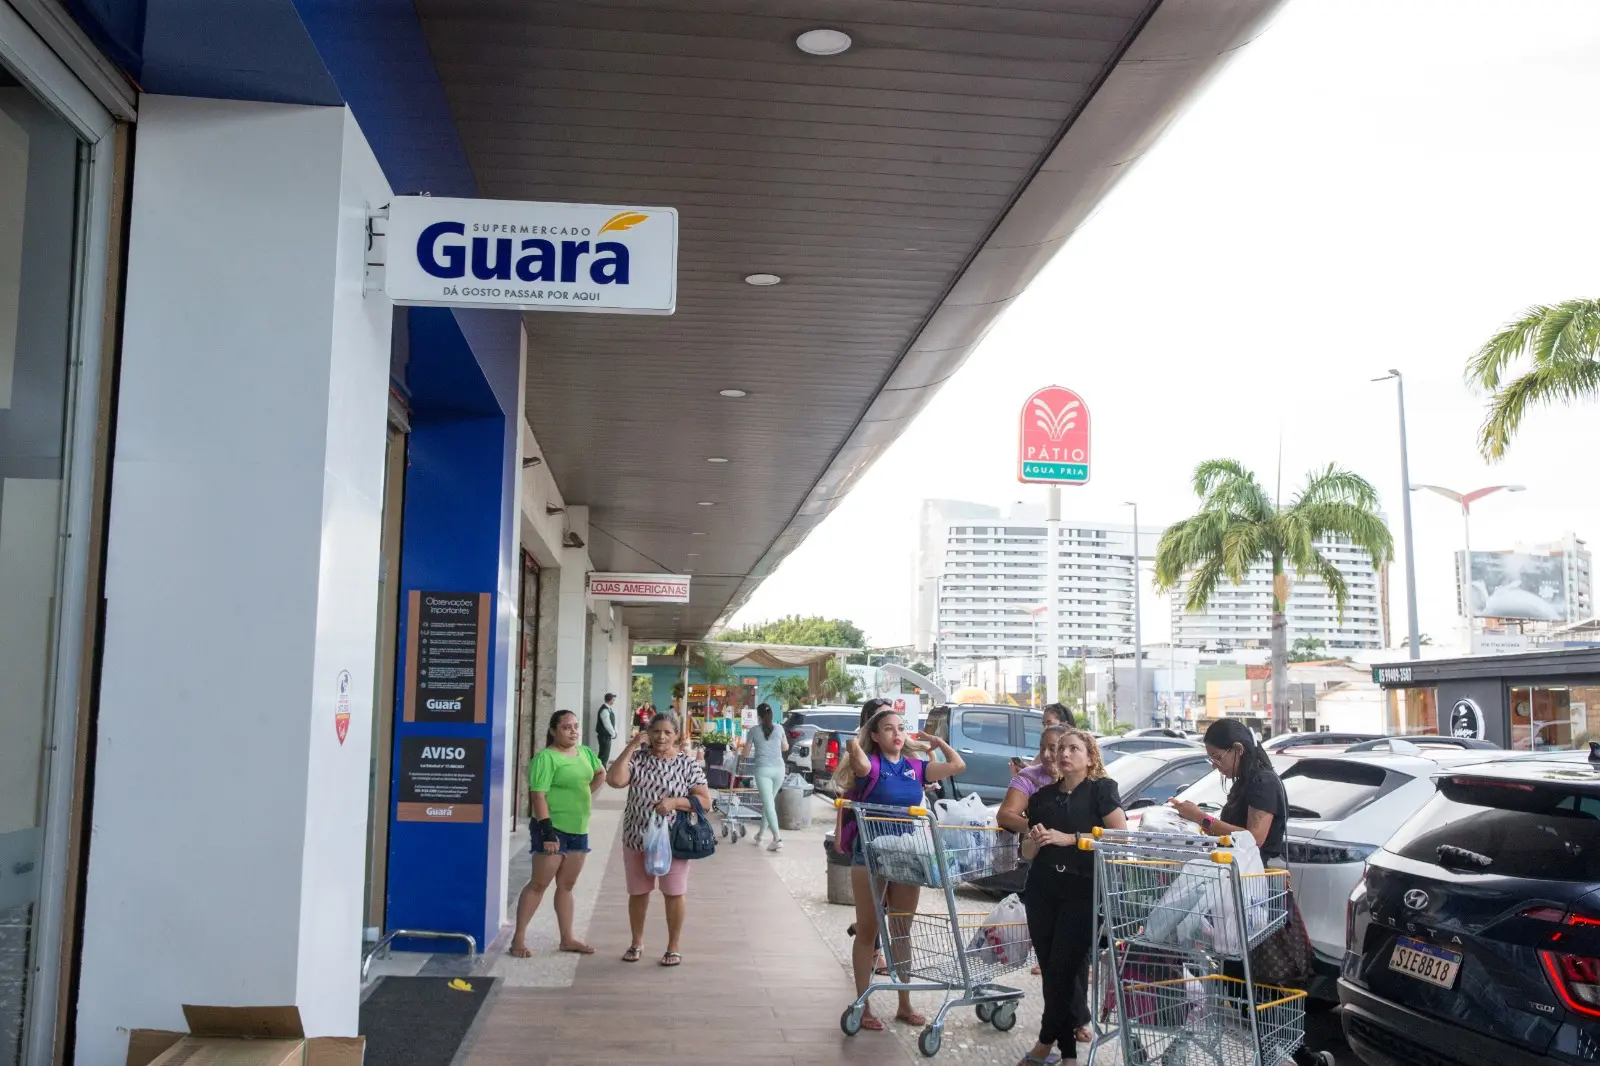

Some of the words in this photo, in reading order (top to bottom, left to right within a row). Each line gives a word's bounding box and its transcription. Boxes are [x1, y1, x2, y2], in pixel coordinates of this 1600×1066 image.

[473, 223, 591, 236] SUPERMERCADO
[443, 285, 459, 296] DÁ
[462, 287, 501, 298] GOSTO
[504, 289, 544, 299] PASSAR
[547, 290, 570, 300] POR
[572, 292, 600, 302] AQUI
[1027, 444, 1084, 461] PÁTIO
[591, 583, 621, 592] LOJAS
[623, 584, 687, 595] AMERICANAS
[425, 597, 473, 607] Observações
[421, 747, 466, 760] AVISO
[1396, 949, 1450, 982] SIE8B18
